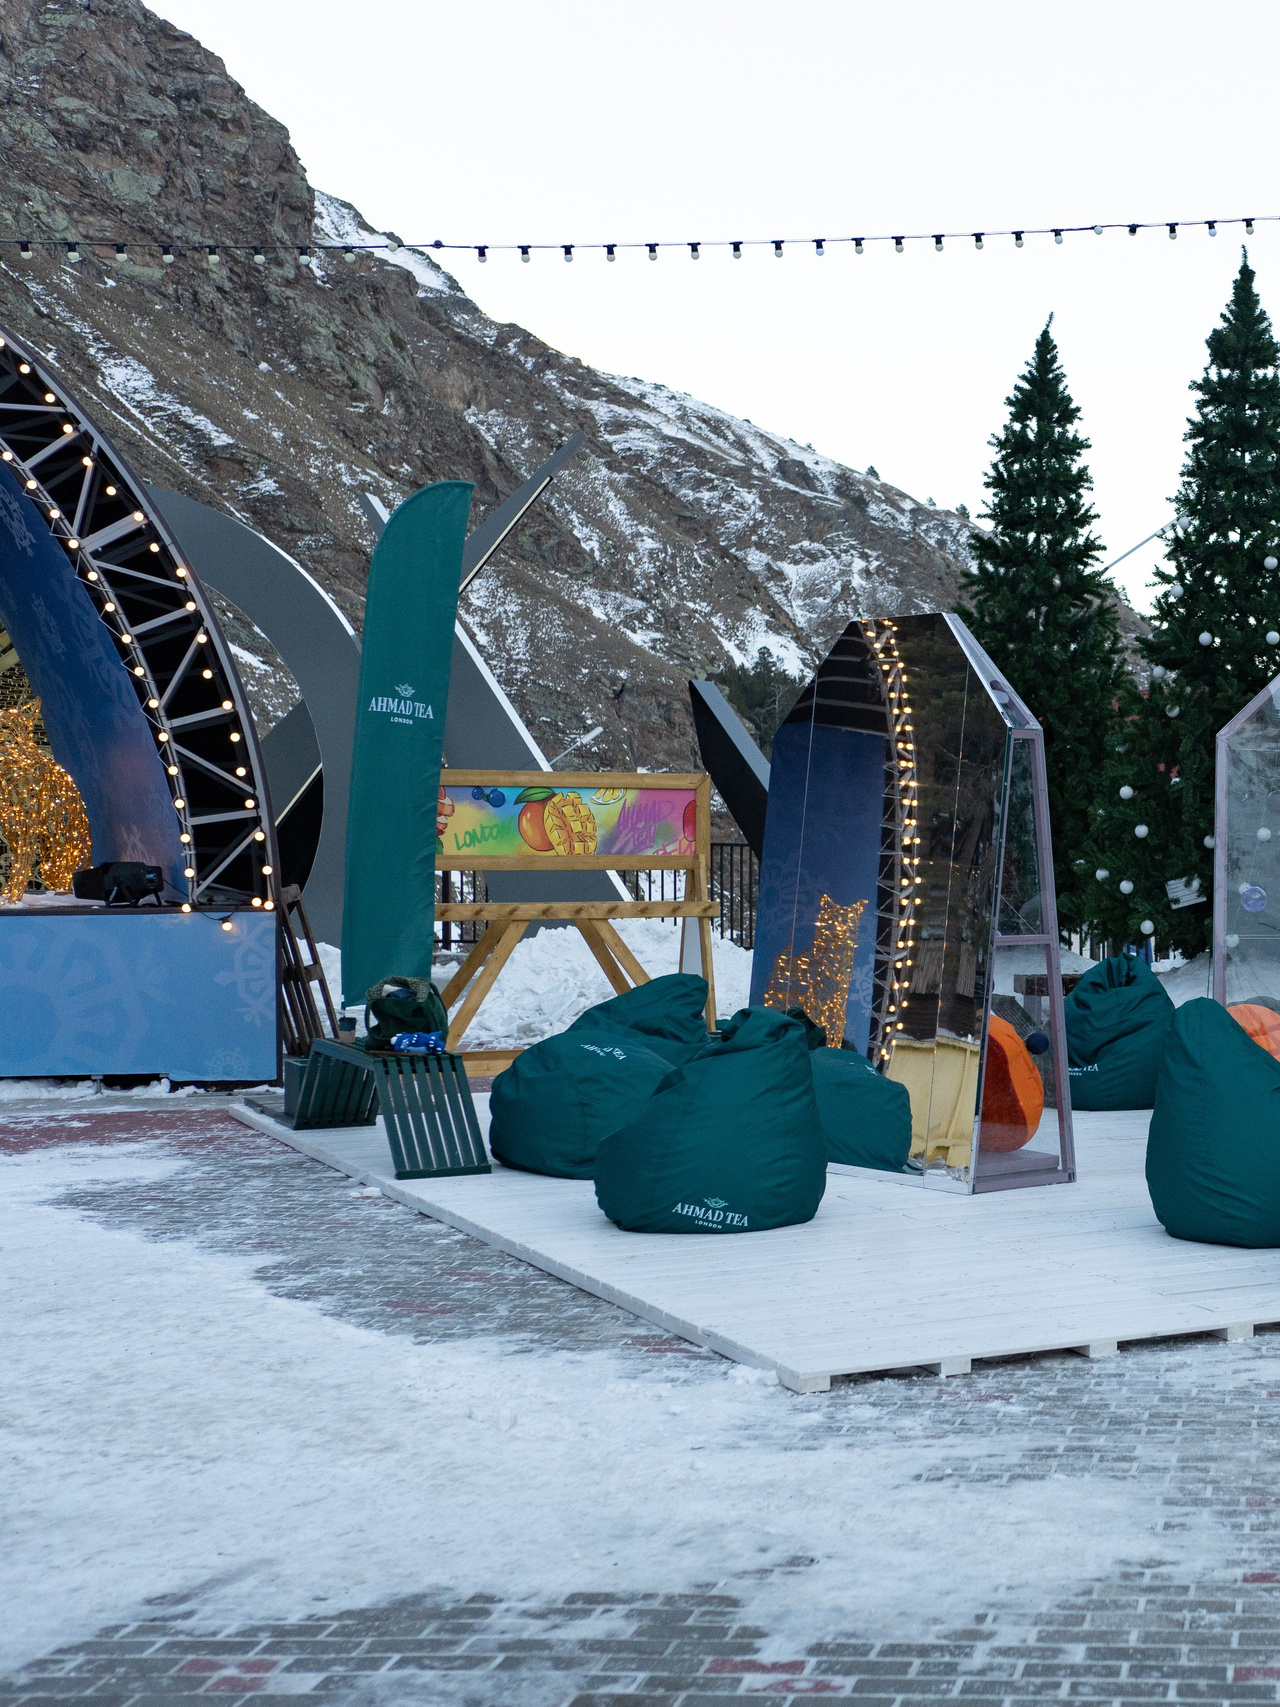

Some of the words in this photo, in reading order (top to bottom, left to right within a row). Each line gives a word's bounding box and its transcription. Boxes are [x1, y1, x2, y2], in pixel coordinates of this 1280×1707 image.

[368, 696, 413, 716] AHMAD
[413, 702, 434, 720] TEA
[390, 716, 413, 725] LONDON
[454, 818, 514, 851] LONDON
[671, 1202, 724, 1222] AHMAD
[725, 1212, 749, 1228] TEA
[694, 1219, 723, 1230] LONDON
